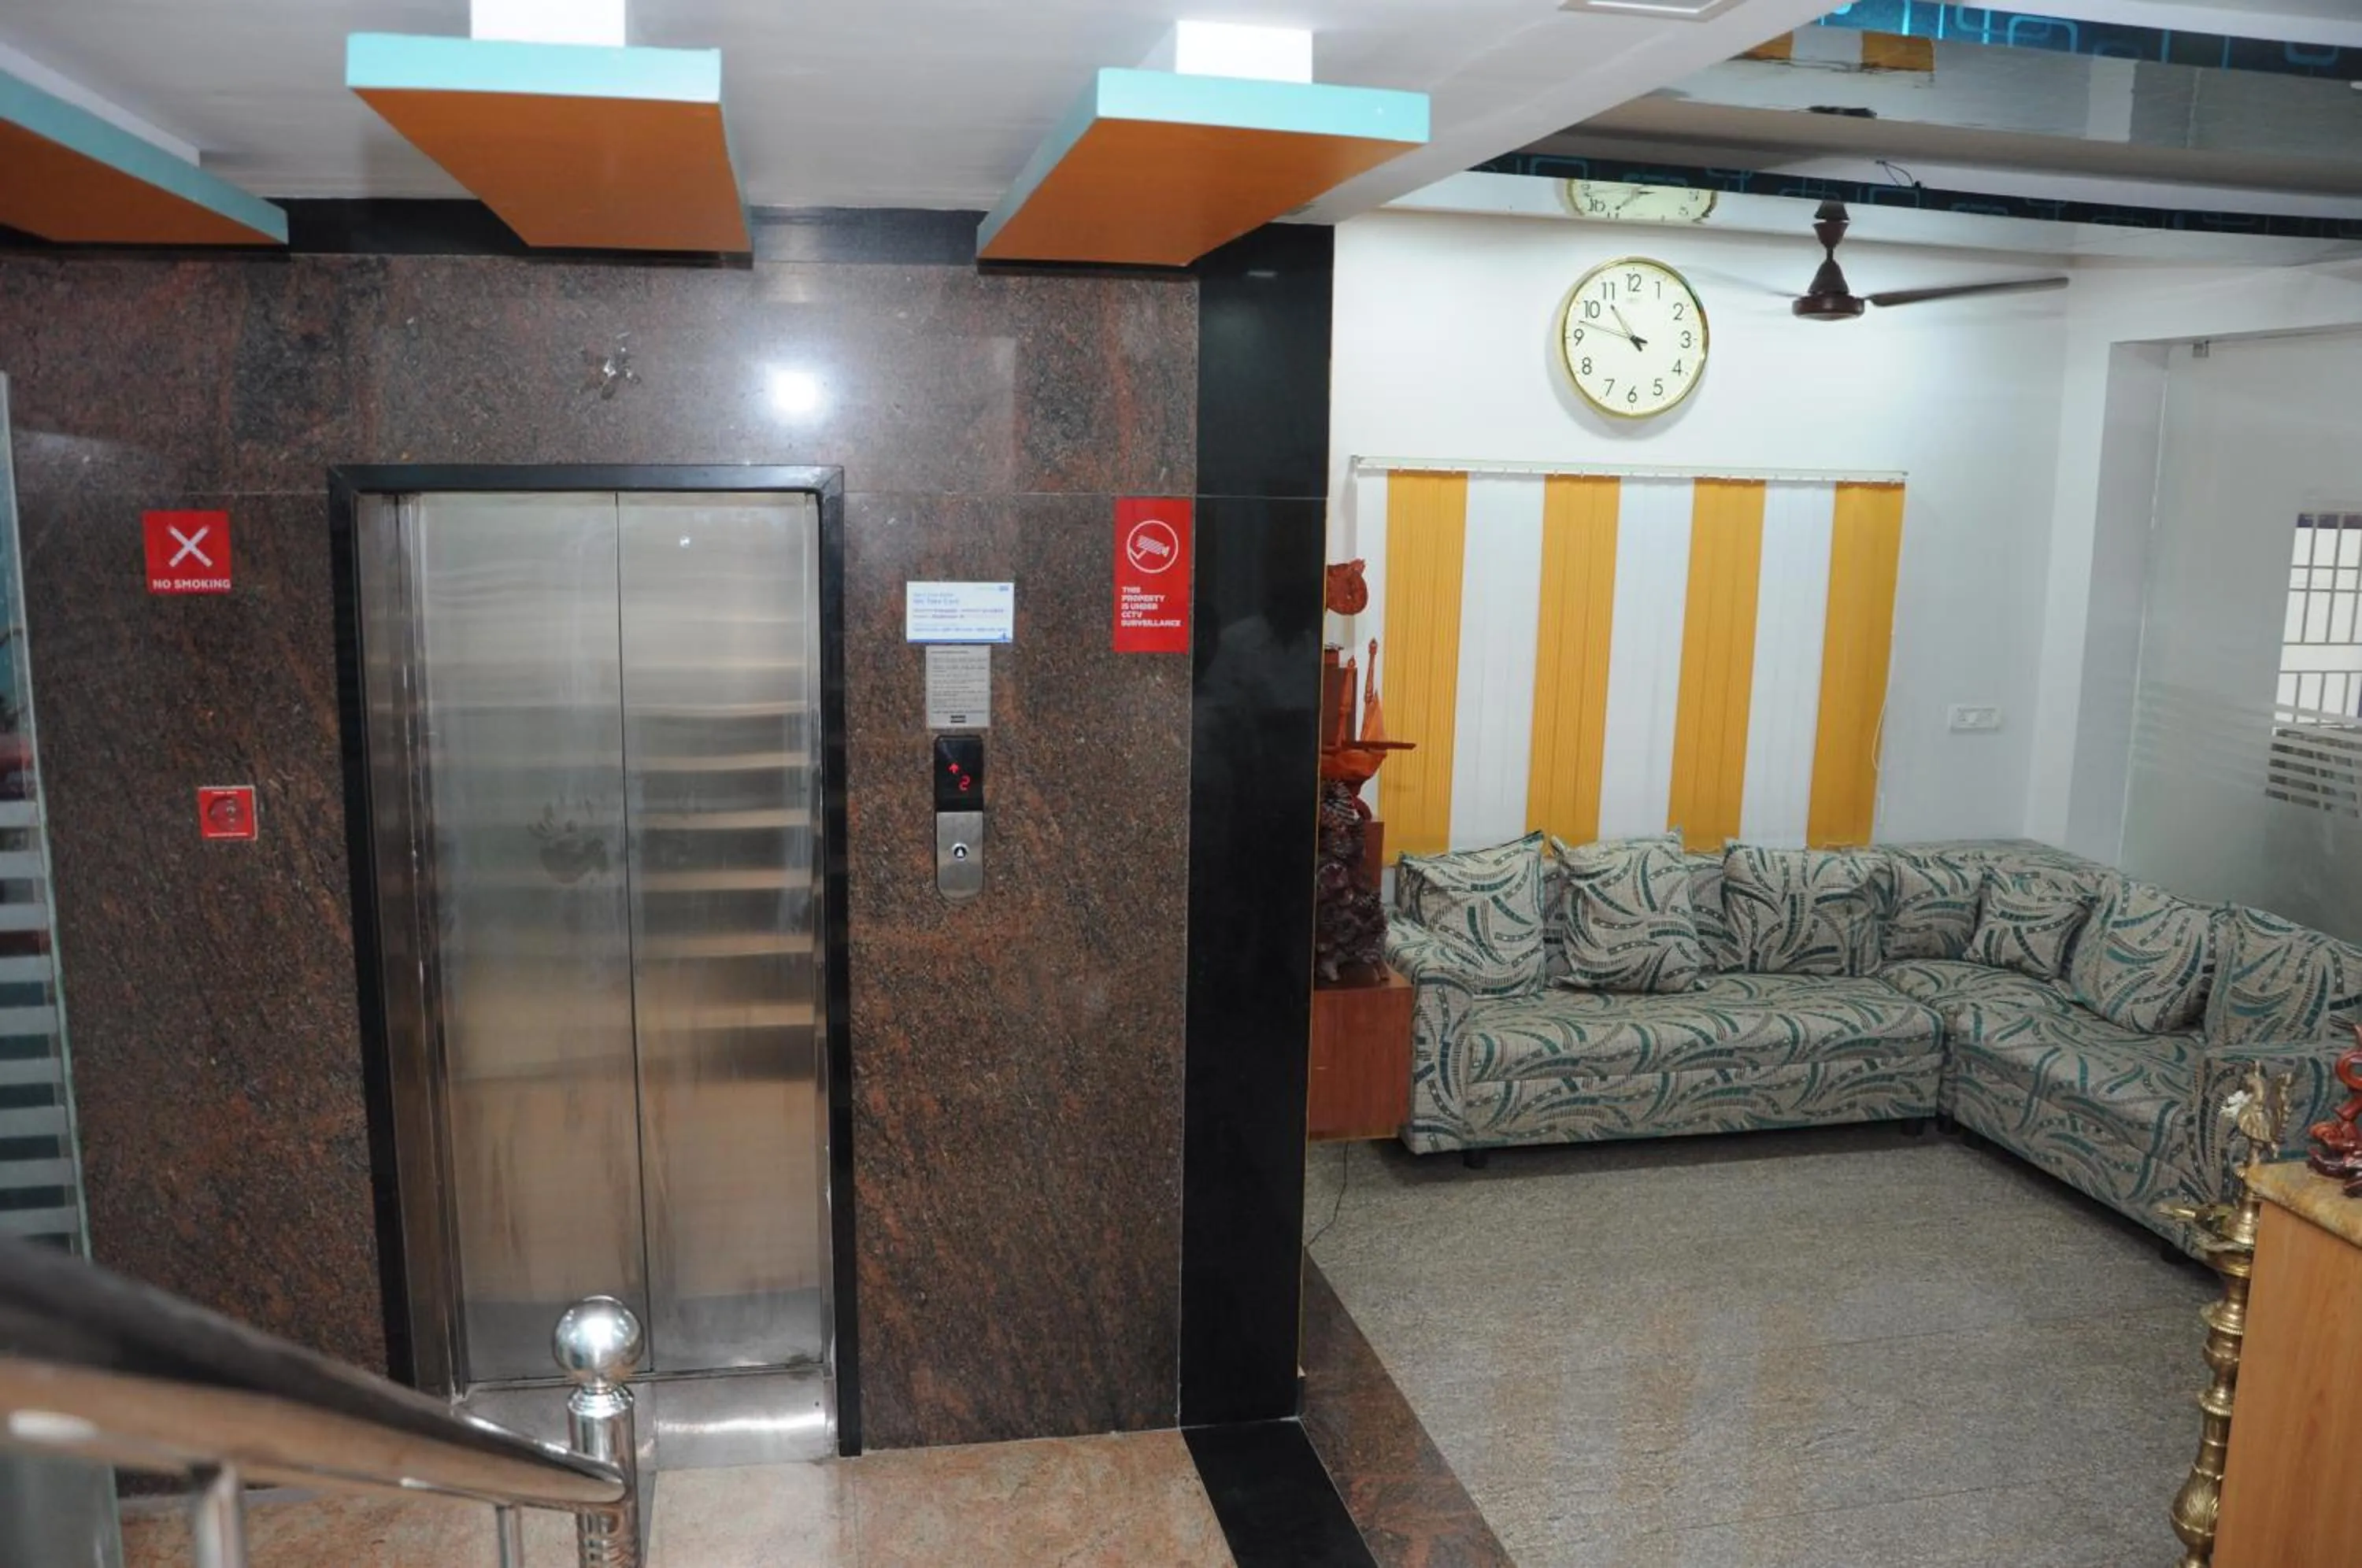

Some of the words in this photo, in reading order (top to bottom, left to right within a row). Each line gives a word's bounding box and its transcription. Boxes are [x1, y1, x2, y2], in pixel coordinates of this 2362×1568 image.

[1601, 282, 1616, 301] 11
[1626, 273, 1642, 292] 12
[1655, 281, 1660, 299] 1
[1583, 300, 1601, 319] 10
[1673, 302, 1684, 320] 2
[1574, 328, 1584, 346] 9
[1681, 331, 1691, 349] 3
[1582, 357, 1592, 375] 8
[1672, 359, 1682, 376] 4
[1604, 379, 1615, 397] 7
[1627, 386, 1638, 404] 6
[1653, 378, 1664, 397] 5
[153, 579, 171, 590] NO
[174, 579, 231, 590] SMOKING
[958, 774, 971, 790] 2
